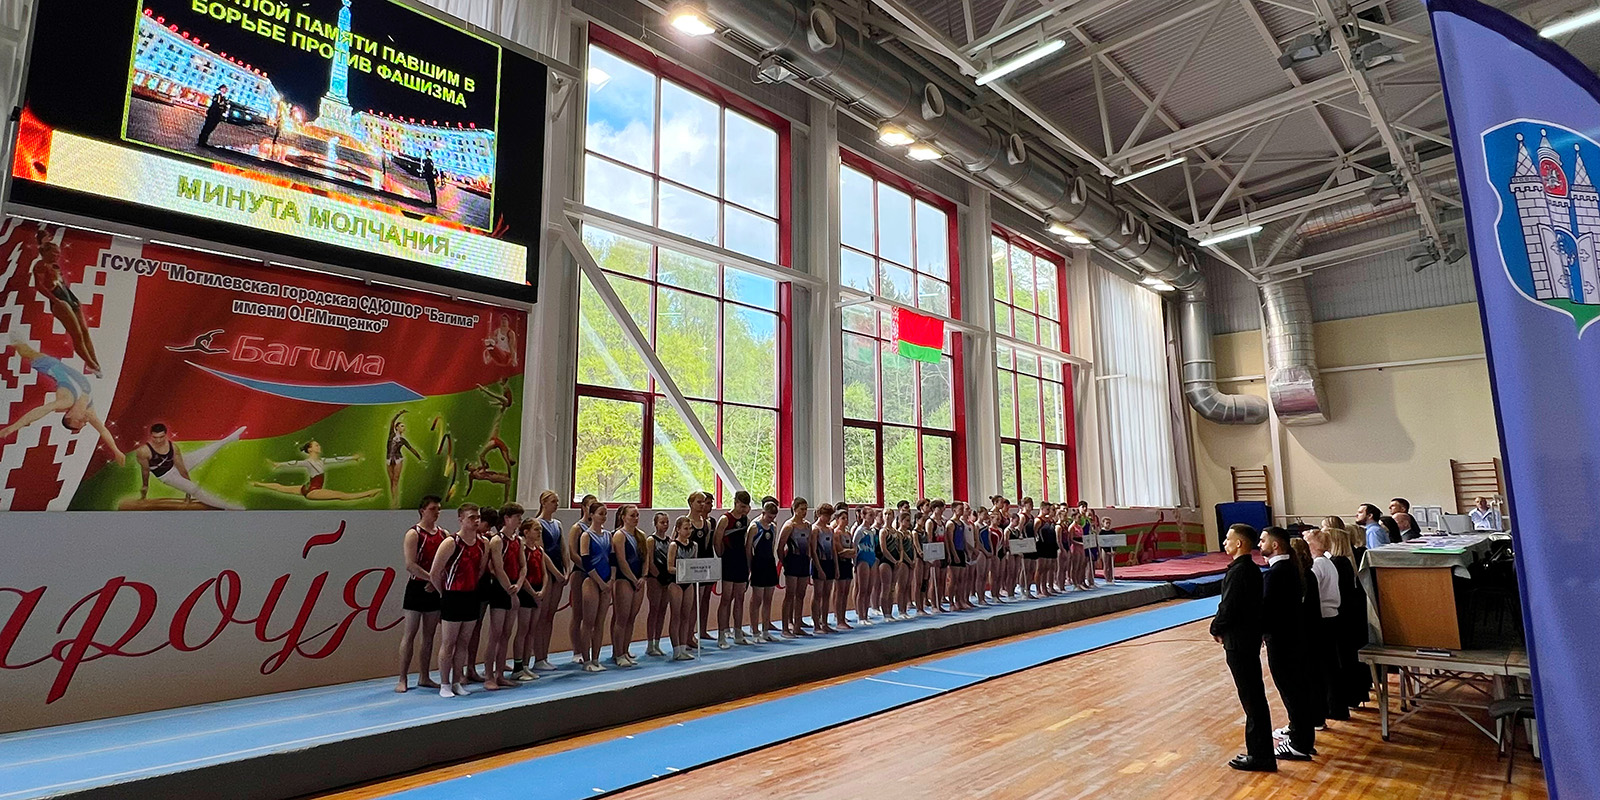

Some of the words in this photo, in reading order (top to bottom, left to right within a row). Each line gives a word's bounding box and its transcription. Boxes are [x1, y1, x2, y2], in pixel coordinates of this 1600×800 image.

[192, 0, 287, 43] БОРЬБЕ
[292, 31, 372, 74] ПРОТИВ
[377, 63, 467, 108] ФАШИЗМА
[297, 13, 378, 57] ПАМЯТИ
[382, 45, 461, 87] ПАВШИМ
[464, 76, 476, 93] В
[177, 174, 301, 224] МИНУТА
[308, 206, 467, 261] МОЛЧАНИЯ...
[99, 252, 159, 275] ГСУСУ
[163, 263, 278, 296] "Могилевская
[282, 286, 357, 309] городская
[360, 296, 421, 319] СДЮШОР
[425, 307, 479, 328] "Багима"
[232, 300, 286, 318] имени
[289, 306, 389, 333] О.Г.Мищенко"
[232, 335, 386, 377] Багима
